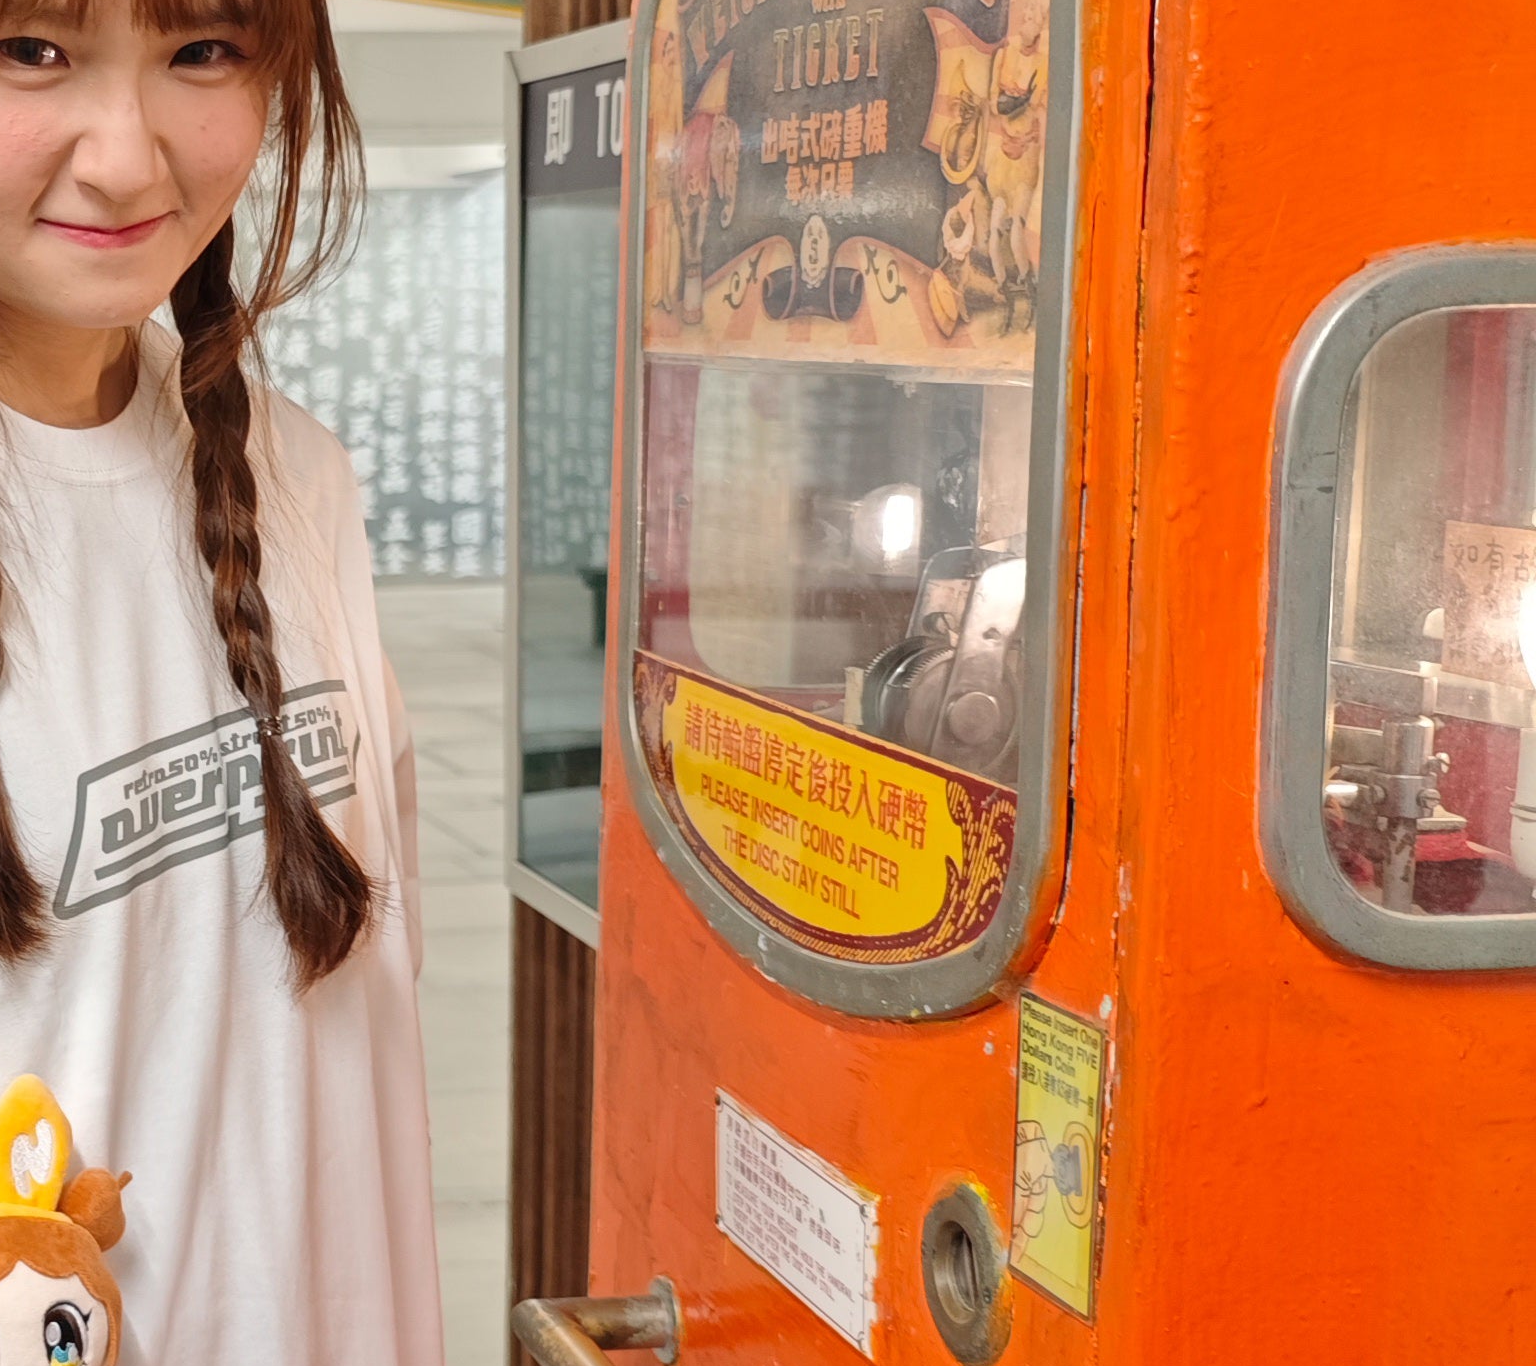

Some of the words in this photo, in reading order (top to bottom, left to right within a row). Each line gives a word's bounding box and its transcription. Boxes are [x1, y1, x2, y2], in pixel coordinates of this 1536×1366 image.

[773, 8, 884, 93] TICKET
[544, 87, 575, 166] 即
[685, 699, 928, 850] 請待輪盤停定後投入硬幣
[701, 773, 749, 819] PLEASE
[750, 796, 799, 842] INSERT
[800, 820, 845, 866] COINS
[848, 842, 900, 893] AFTER
[722, 824, 748, 861] THE
[749, 839, 781, 877] DISC
[781, 854, 818, 897] STAY
[819, 874, 861, 920] STILL
[1022, 1019, 1047, 1048] Hong
[1048, 1032, 1075, 1062] Kong
[1076, 1046, 1099, 1071] FIVE
[1079, 1028, 1099, 1051] One
